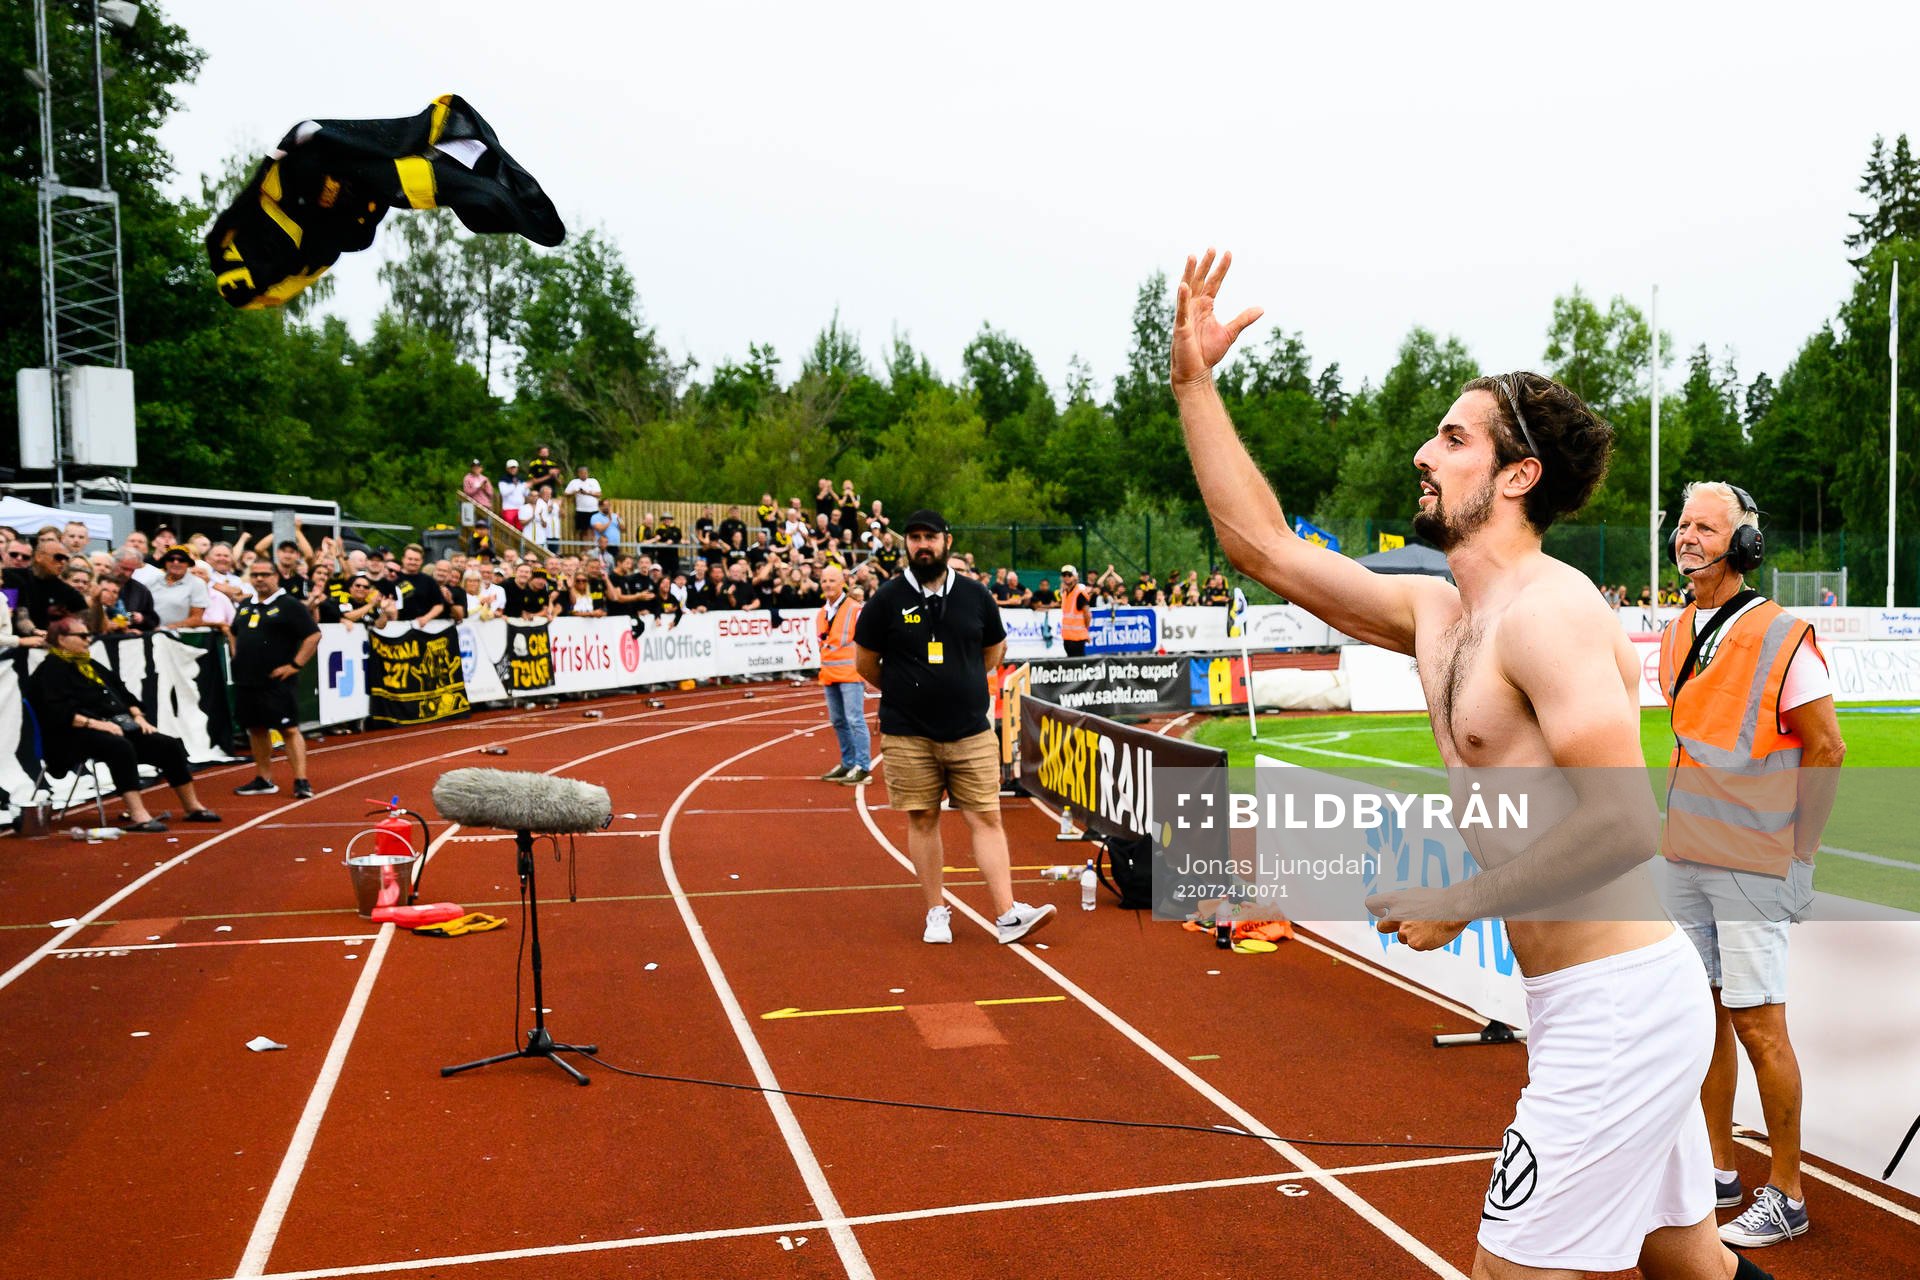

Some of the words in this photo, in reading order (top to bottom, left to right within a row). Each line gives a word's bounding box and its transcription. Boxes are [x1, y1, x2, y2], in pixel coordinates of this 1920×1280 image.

[719, 616, 809, 637] SÖDERORT
[904, 614, 921, 624] SLO
[1161, 618, 1197, 640] bsv
[1086, 623, 1152, 647] rafikskola
[551, 632, 611, 674] friskis
[643, 634, 712, 662] AllOffice
[1031, 662, 1106, 684] Mechanical
[1109, 663, 1140, 682] parts
[1140, 662, 1179, 682] expert
[1060, 687, 1158, 708] www.sacltd.com
